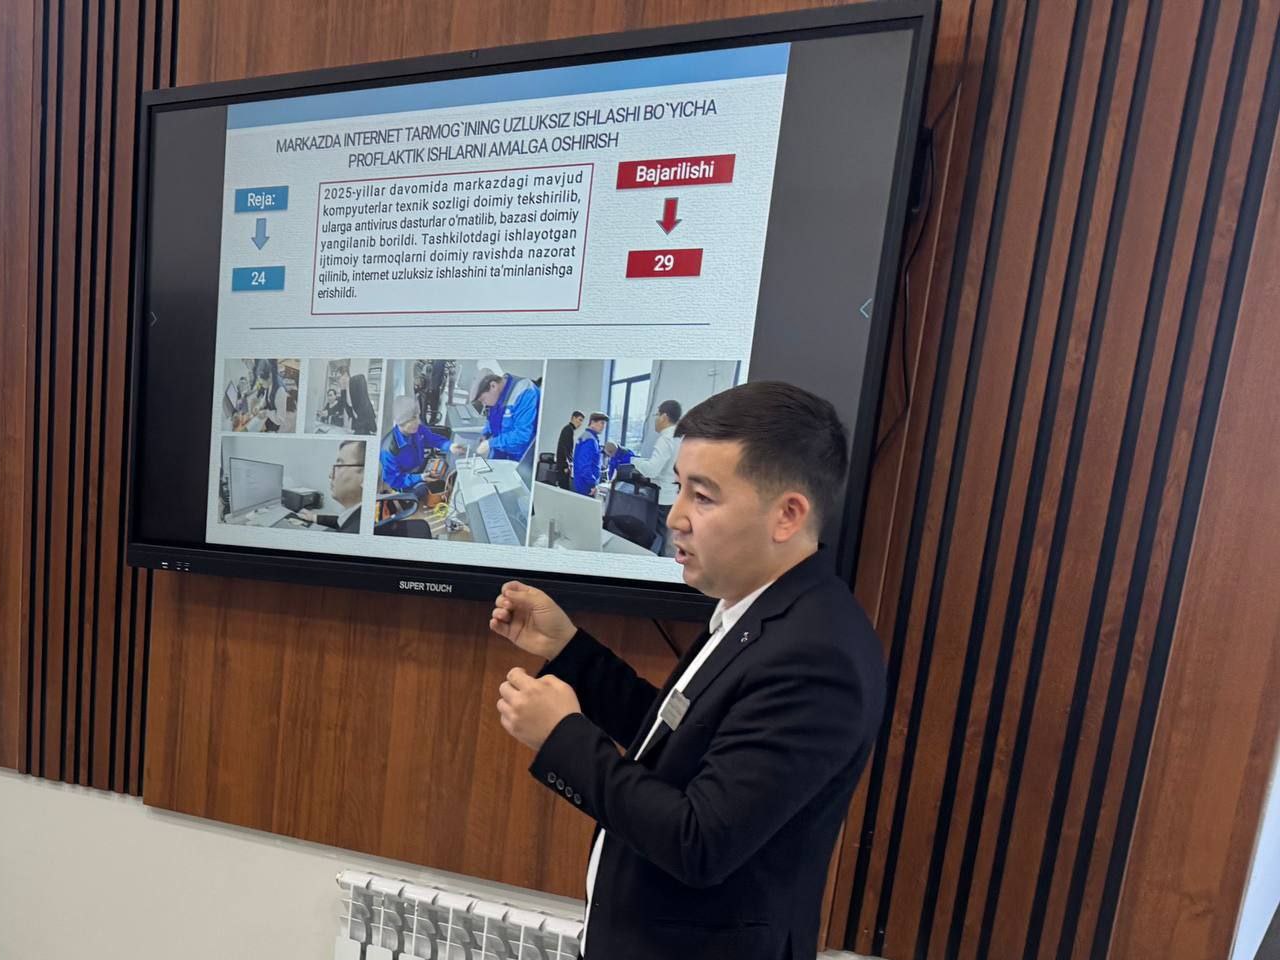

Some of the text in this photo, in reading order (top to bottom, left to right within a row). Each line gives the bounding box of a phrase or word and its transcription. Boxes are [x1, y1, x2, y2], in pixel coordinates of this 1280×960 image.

[276, 133, 341, 152] MARKAZDA
[343, 128, 403, 147] INTERNET
[503, 112, 570, 133] UZLUKSIZ
[573, 106, 640, 127] ISHLASHI
[348, 132, 619, 168] PROFLAKTIK ISHLARNI AMALGA OSHIRISH
[635, 160, 715, 186] Bajarilishi
[324, 171, 583, 201] 2025-yillar davomida markazdagi mavjud
[247, 192, 276, 209] Reja:
[323, 190, 580, 218] kompyuterlar texnik sozligi doimiy tekshirilib,
[322, 221, 352, 235] ularga
[355, 219, 398, 232] antivirus
[400, 216, 447, 229] dasturlar
[500, 210, 537, 224] bazasi
[540, 208, 579, 223] doimiy
[320, 228, 577, 252] yangilanib borildi. Tashkilotdagi ishlayotgan
[319, 245, 576, 268] ijtimoiy tarmoqlarni doimiy ravishda nazorat
[653, 254, 674, 271] 29
[251, 271, 266, 285] 24
[318, 270, 350, 284] qilinib,
[352, 270, 389, 281] internet
[391, 267, 433, 280] uzluksiz
[436, 265, 487, 279] ishlashini
[318, 287, 357, 299] erishildi.
[399, 581, 452, 593] SUPER TOUCH
